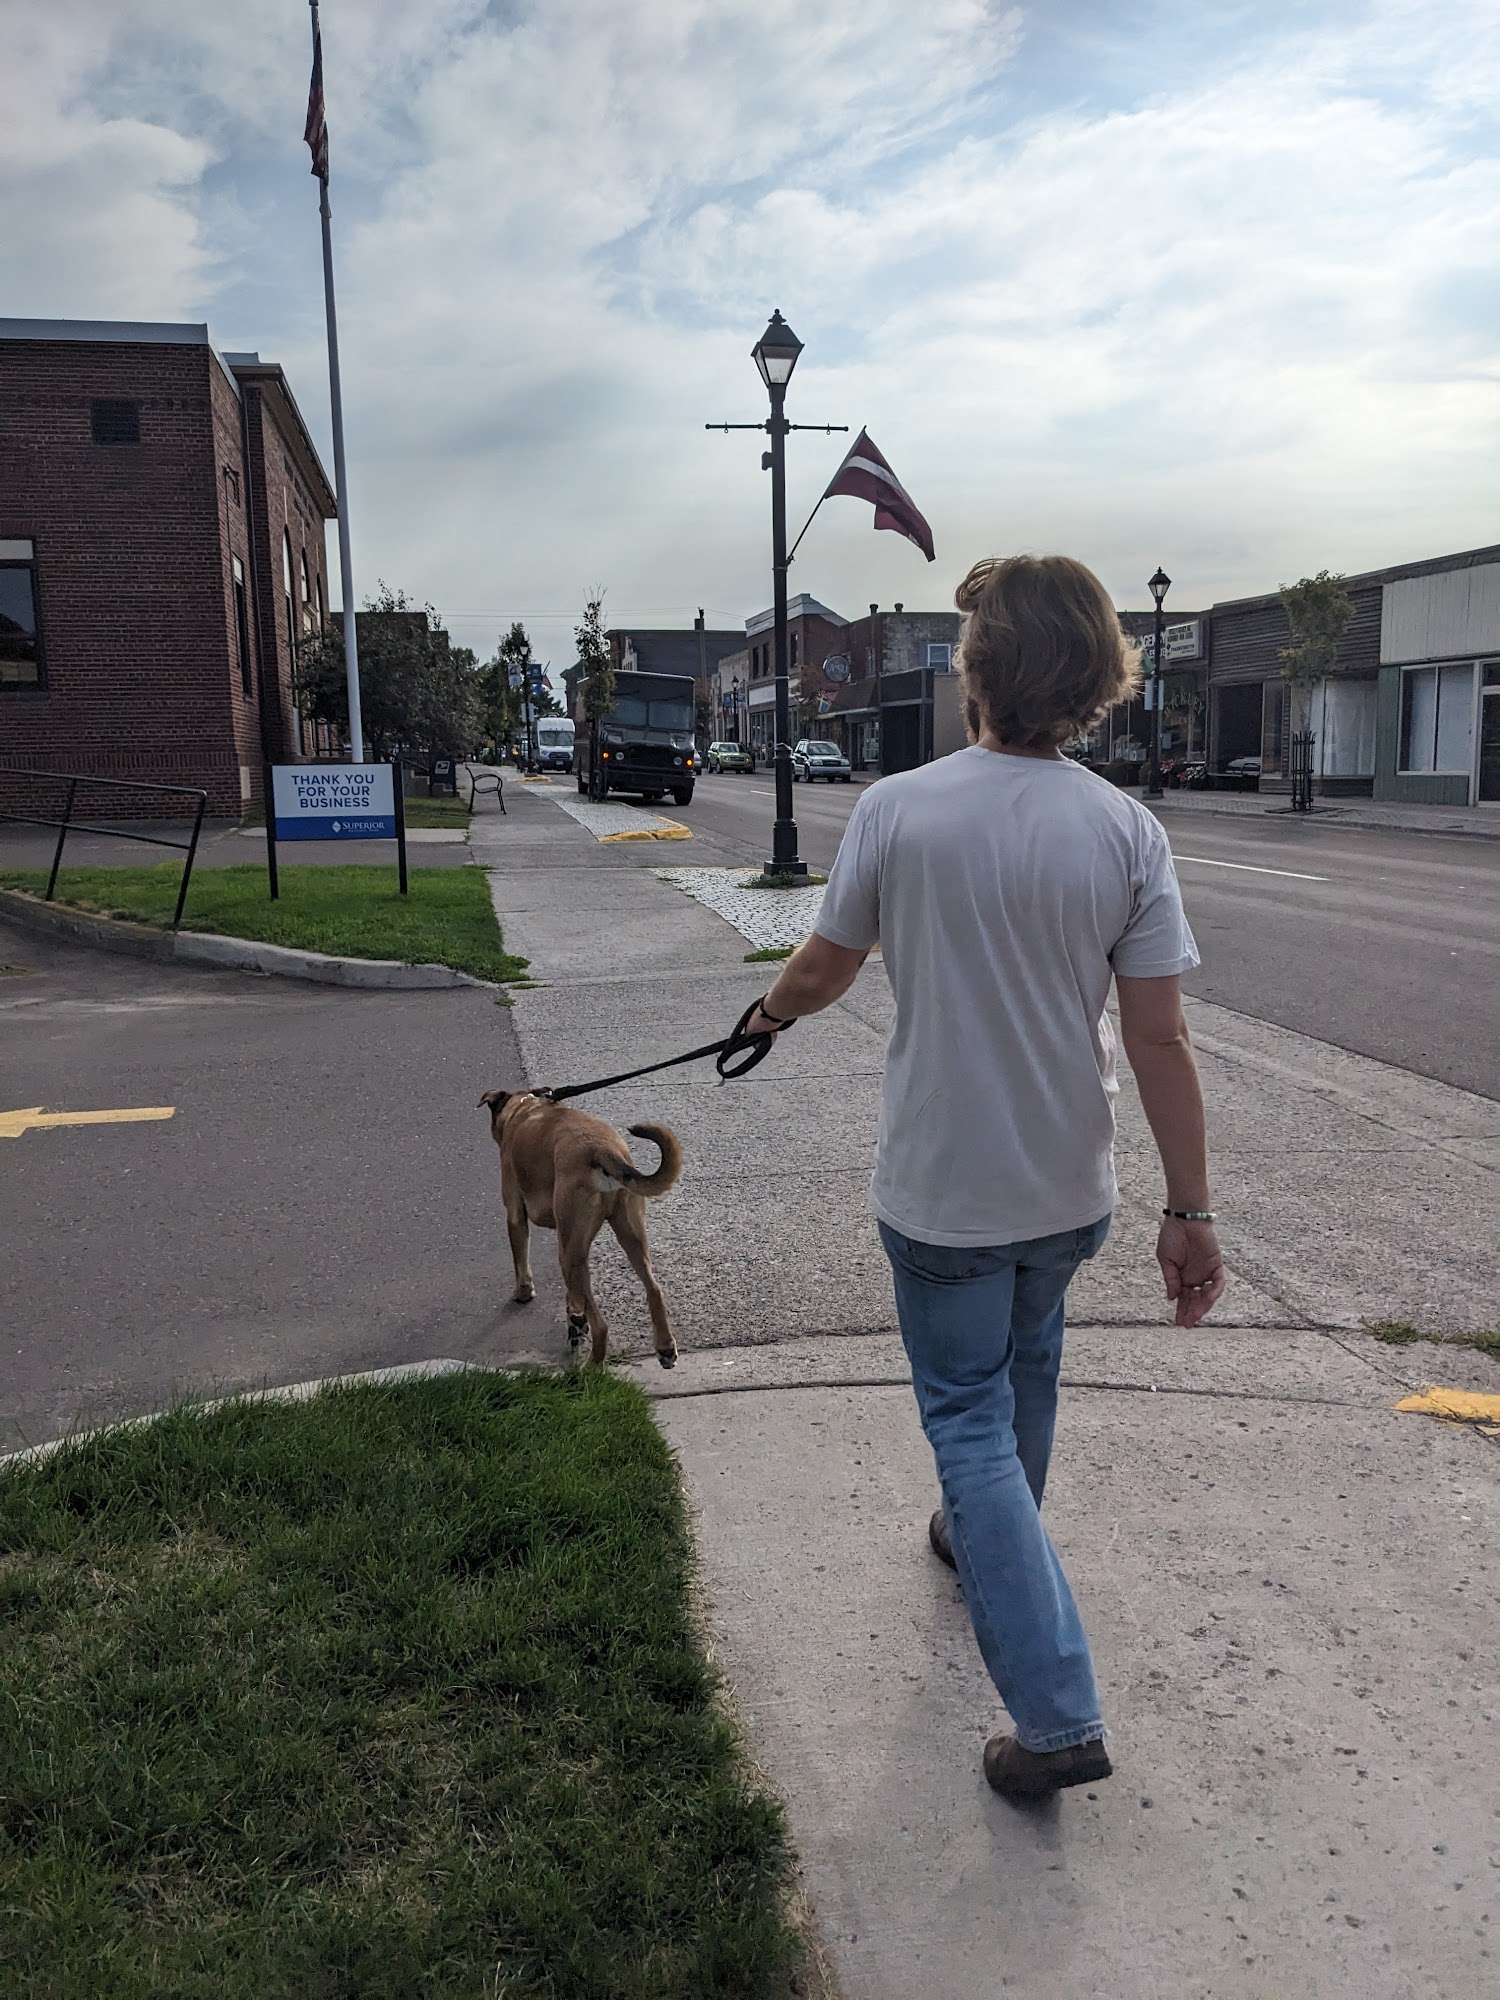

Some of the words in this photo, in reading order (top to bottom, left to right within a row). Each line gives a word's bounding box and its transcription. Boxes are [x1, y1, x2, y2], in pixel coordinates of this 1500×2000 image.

[291, 774, 340, 785] THANK
[345, 774, 375, 784] YOU
[297, 786, 326, 797] FOR
[330, 786, 370, 796] YOUR
[300, 797, 370, 808] BUSINESS
[342, 821, 385, 830] SUPERIOR
